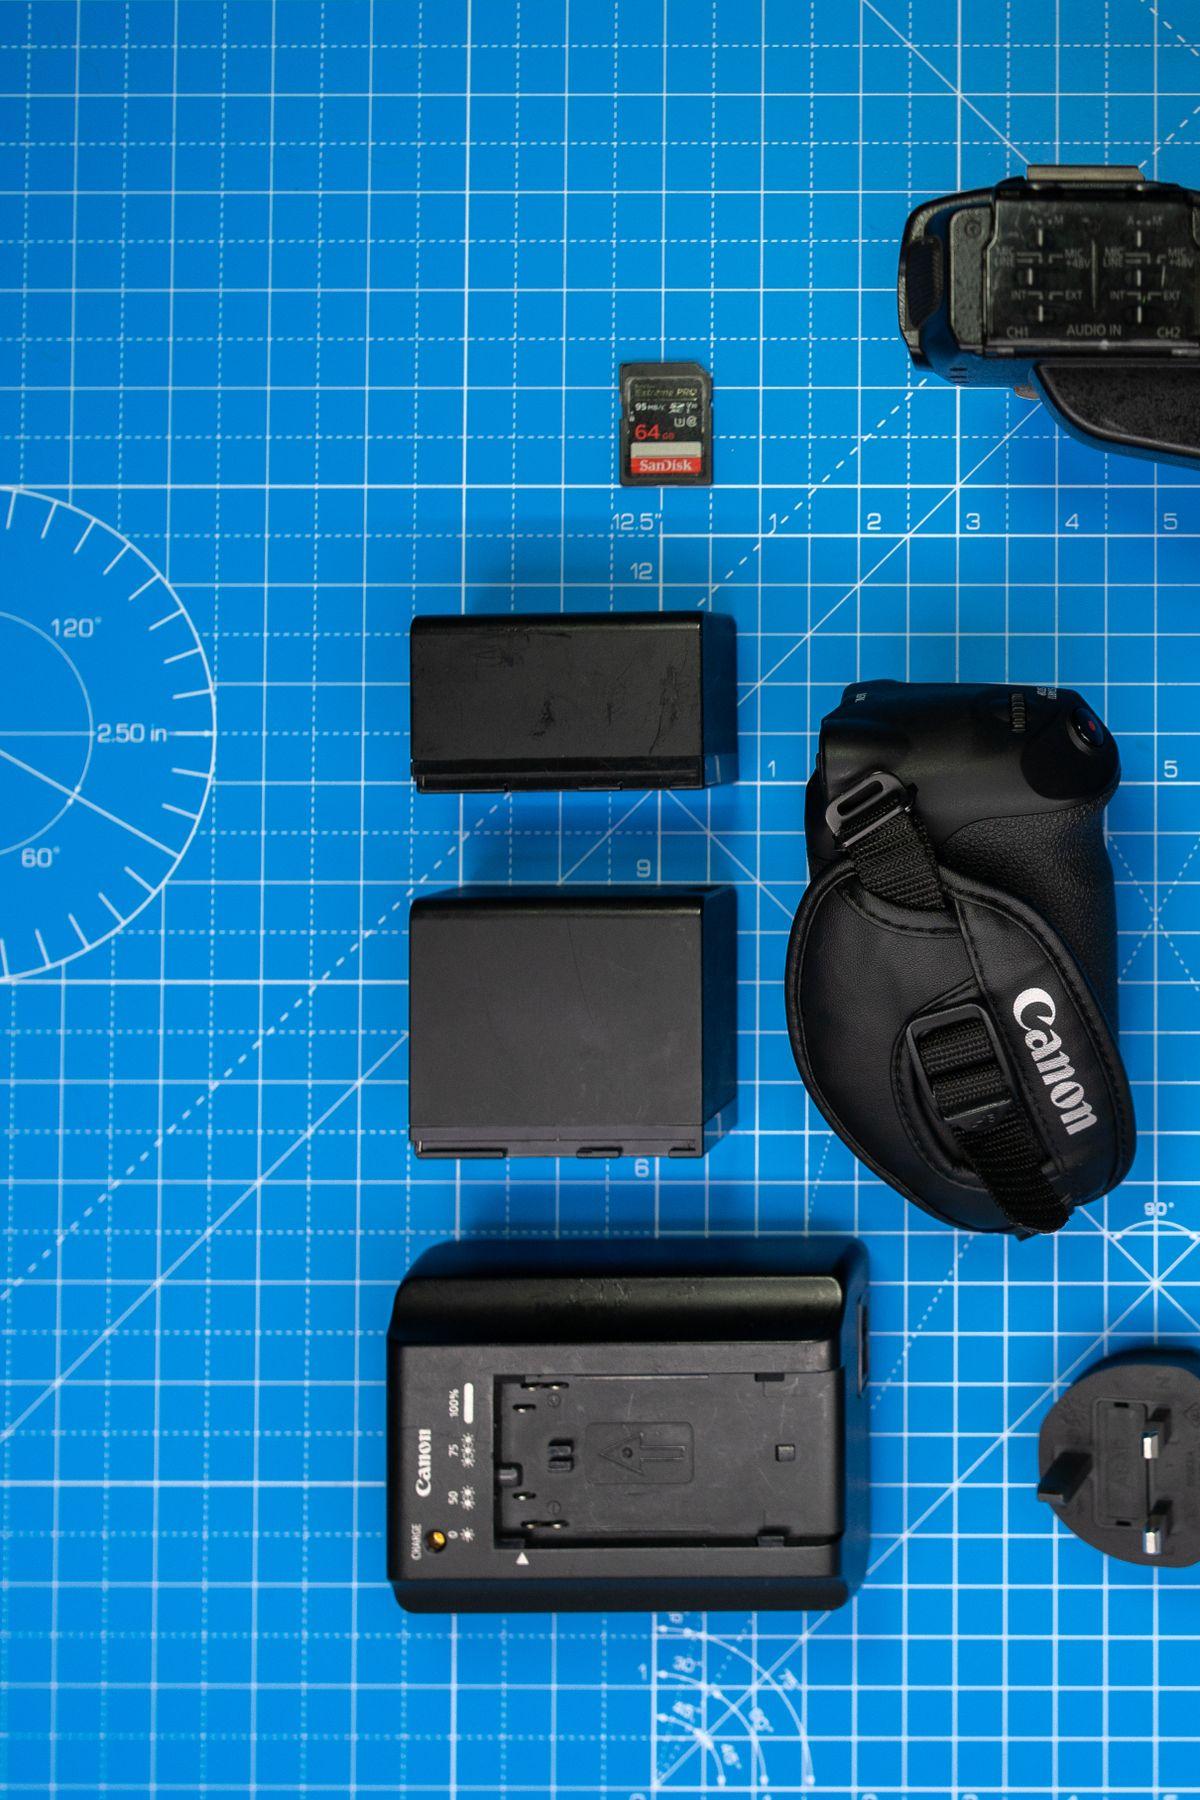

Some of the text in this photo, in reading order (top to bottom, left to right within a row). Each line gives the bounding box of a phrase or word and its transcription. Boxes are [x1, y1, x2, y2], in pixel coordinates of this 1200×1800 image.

[1065, 291, 1082, 300] EXT
[1164, 291, 1180, 301] EXT
[1006, 326, 1029, 338] CH1
[1066, 325, 1122, 337] AUDIO IN
[1157, 327, 1181, 338] CH2
[676, 388, 697, 397] PRO
[635, 423, 659, 440] 64
[640, 459, 692, 471] SanDisk
[867, 513, 881, 530] 2
[966, 513, 980, 530] 3
[1065, 513, 1080, 530] 4
[1164, 513, 1178, 530] 5
[631, 563, 653, 580] 12
[97, 724, 167, 743] 2.50 in
[767, 760, 776, 778] 1
[1164, 761, 1178, 778] 5
[21, 847, 60, 868] 60°
[636, 859, 651, 877] 9
[1012, 986, 1102, 1137] Canon
[634, 1159, 649, 1177] 6
[449, 1388, 460, 1417] 100%
[448, 1444, 459, 1457] 75
[415, 1428, 432, 1498] Canon
[448, 1491, 458, 1505] 50
[411, 1523, 422, 1561] CHARGE
